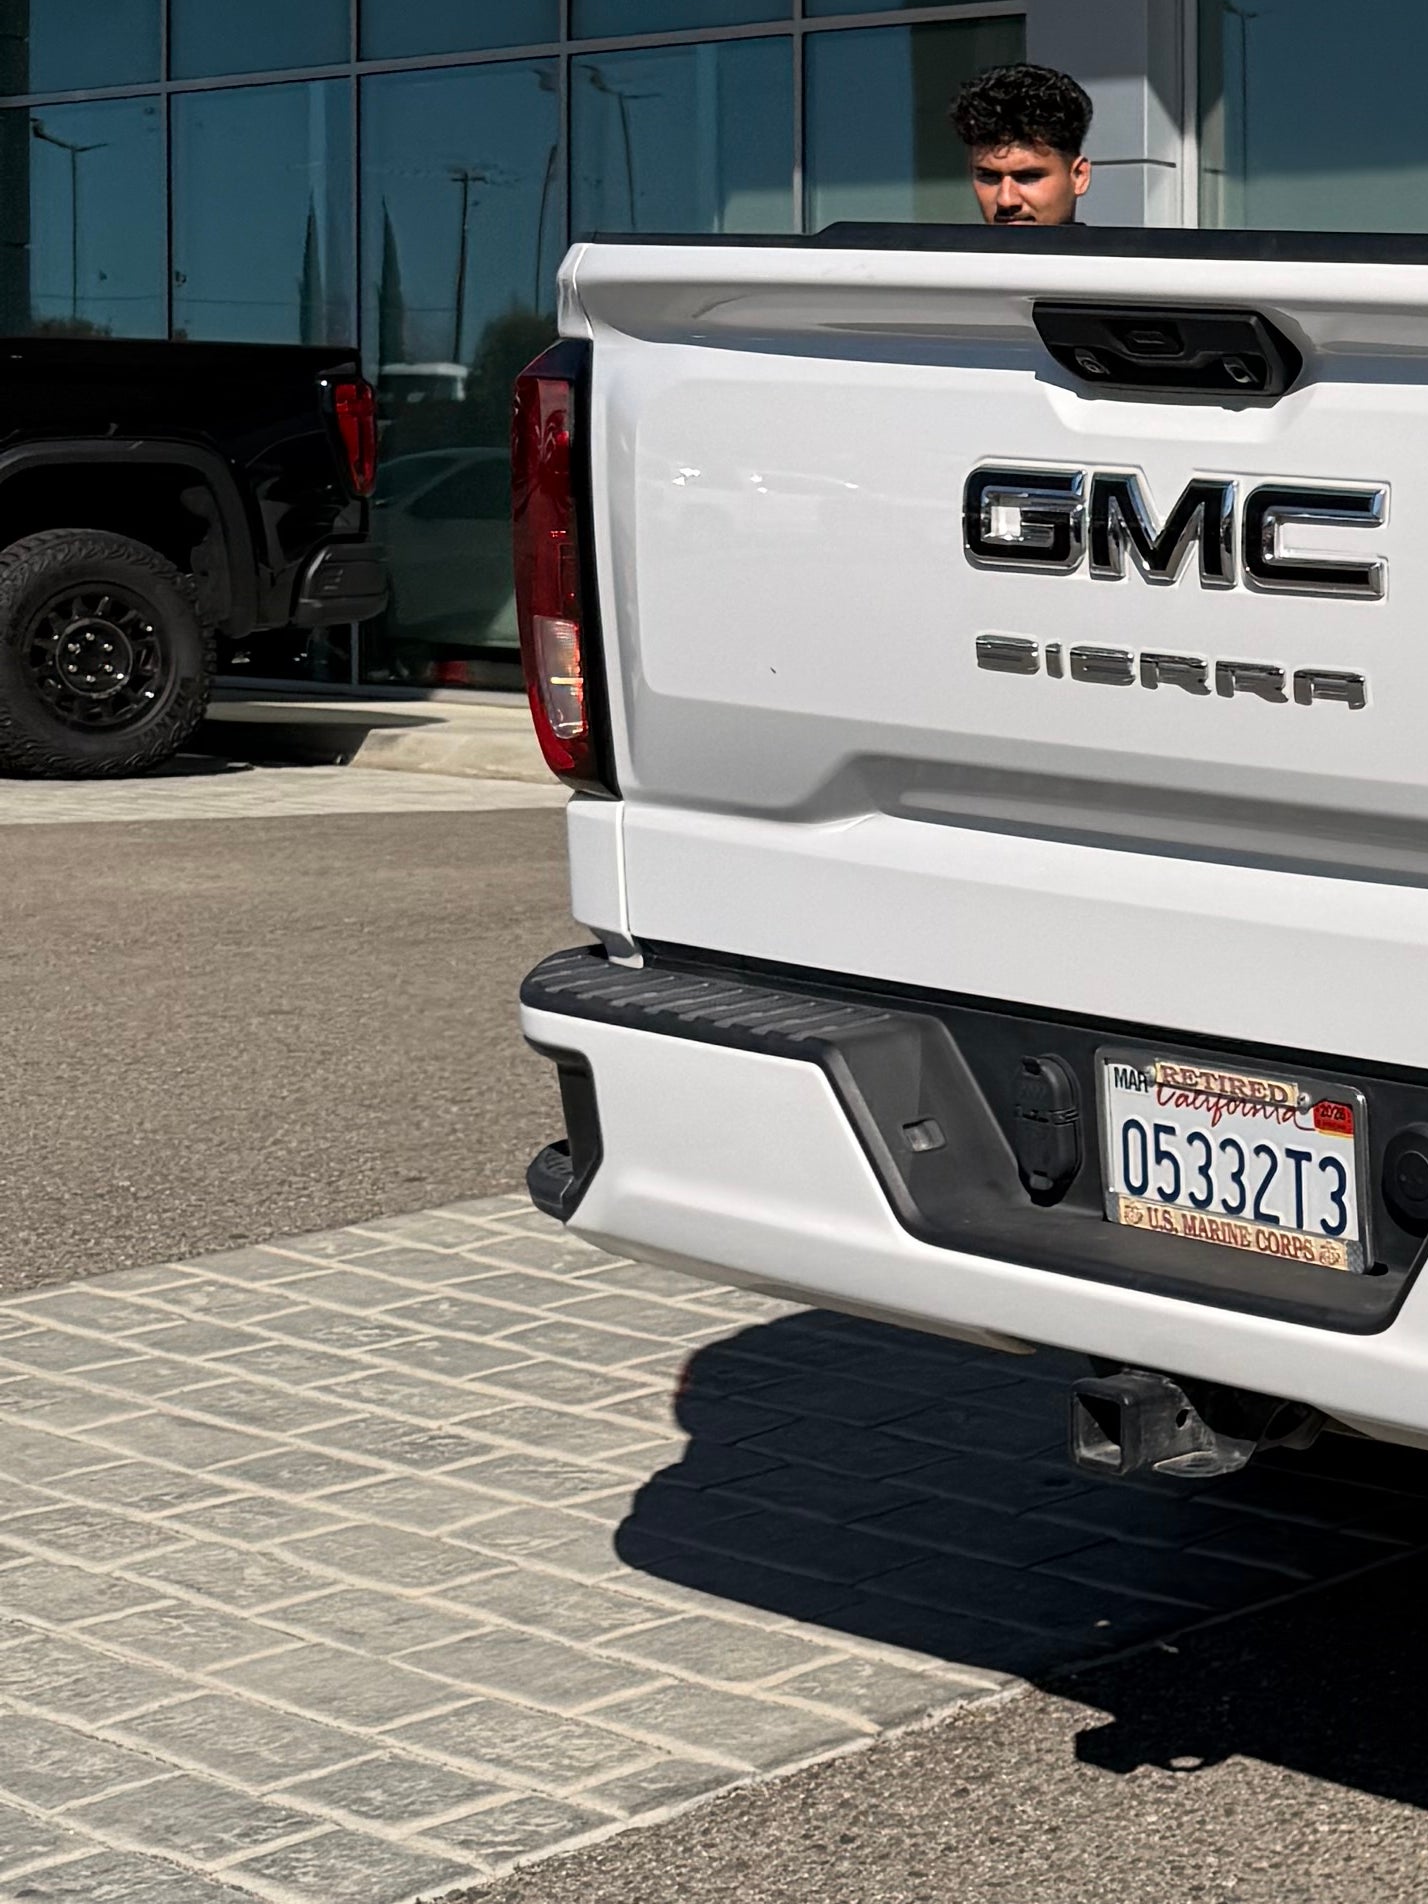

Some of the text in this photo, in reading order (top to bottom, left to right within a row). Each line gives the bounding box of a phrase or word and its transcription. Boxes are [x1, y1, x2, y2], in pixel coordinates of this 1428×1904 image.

[962, 462, 1390, 602] GMC
[975, 634, 1369, 710] SIERRA
[1113, 1066, 1149, 1093] MAR
[1159, 1064, 1290, 1104] RETIRED
[1122, 1118, 1347, 1237] 05332T3
[1147, 1206, 1315, 1263] U.S. MARINE CORPS
